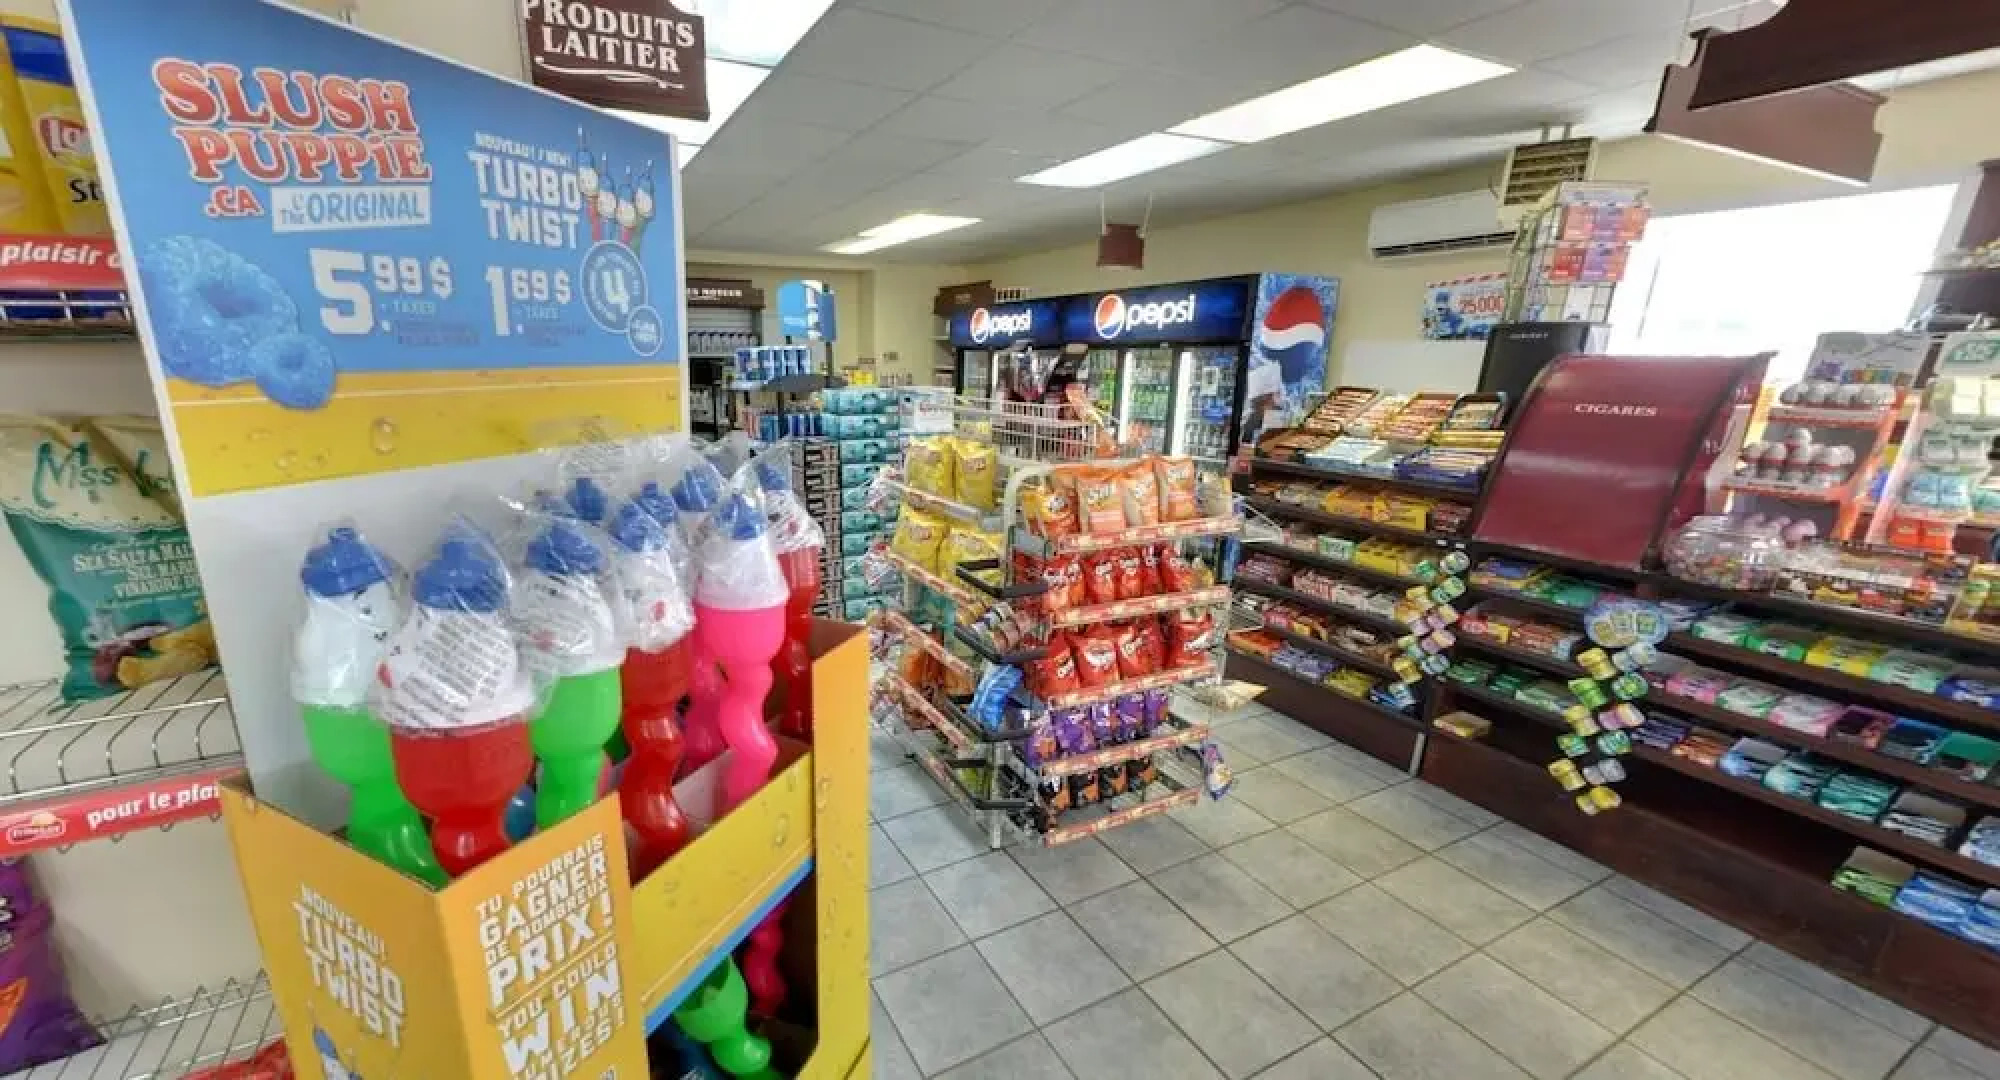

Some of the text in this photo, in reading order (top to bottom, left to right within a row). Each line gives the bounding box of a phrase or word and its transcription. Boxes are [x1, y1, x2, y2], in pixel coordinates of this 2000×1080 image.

[524, 0, 696, 47] PRODUITS
[542, 26, 681, 73] LAITIER
[152, 57, 419, 133] SLUSH
[306, 188, 425, 223] ORIGINAL
[467, 149, 582, 211] TURBO
[479, 199, 580, 250] TWIST
[1, 241, 103, 267] plaisir
[988, 307, 1032, 338] pepsi
[1125, 293, 1196, 332] pepsi
[1573, 403, 1658, 416] CIGARES
[86, 799, 144, 832] pour
[149, 790, 172, 810] le
[475, 831, 604, 921] TU POURRAIS
[479, 851, 607, 949] GAGNER
[483, 874, 609, 968] DE NOMBREUX
[292, 901, 405, 1013] TURBO
[304, 944, 402, 1049] TWIST
[496, 940, 618, 1039] YOU COULD
[501, 959, 621, 1076] WIN
